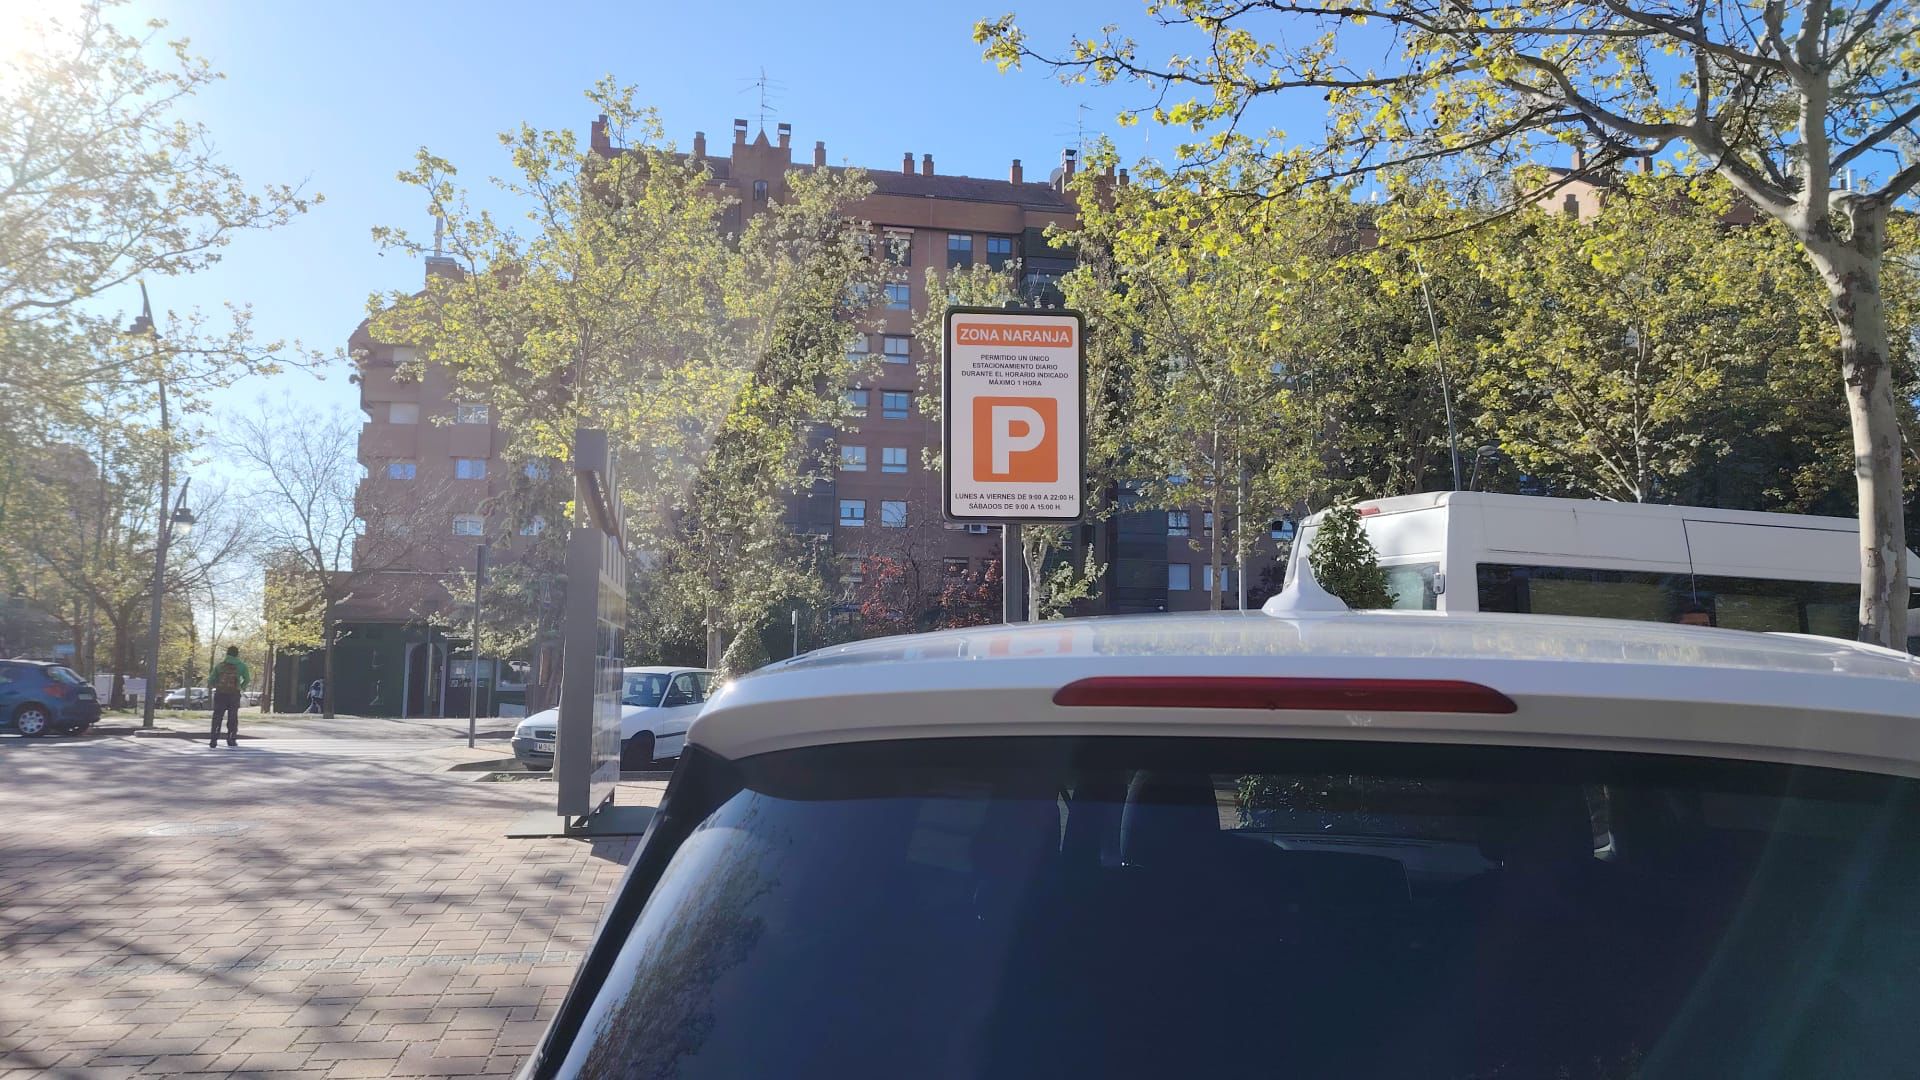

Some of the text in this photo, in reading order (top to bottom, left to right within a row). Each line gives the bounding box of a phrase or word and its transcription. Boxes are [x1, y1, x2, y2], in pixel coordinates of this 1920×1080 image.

[960, 328, 1069, 343] ZONA NARANJA
[991, 406, 1045, 474] P
